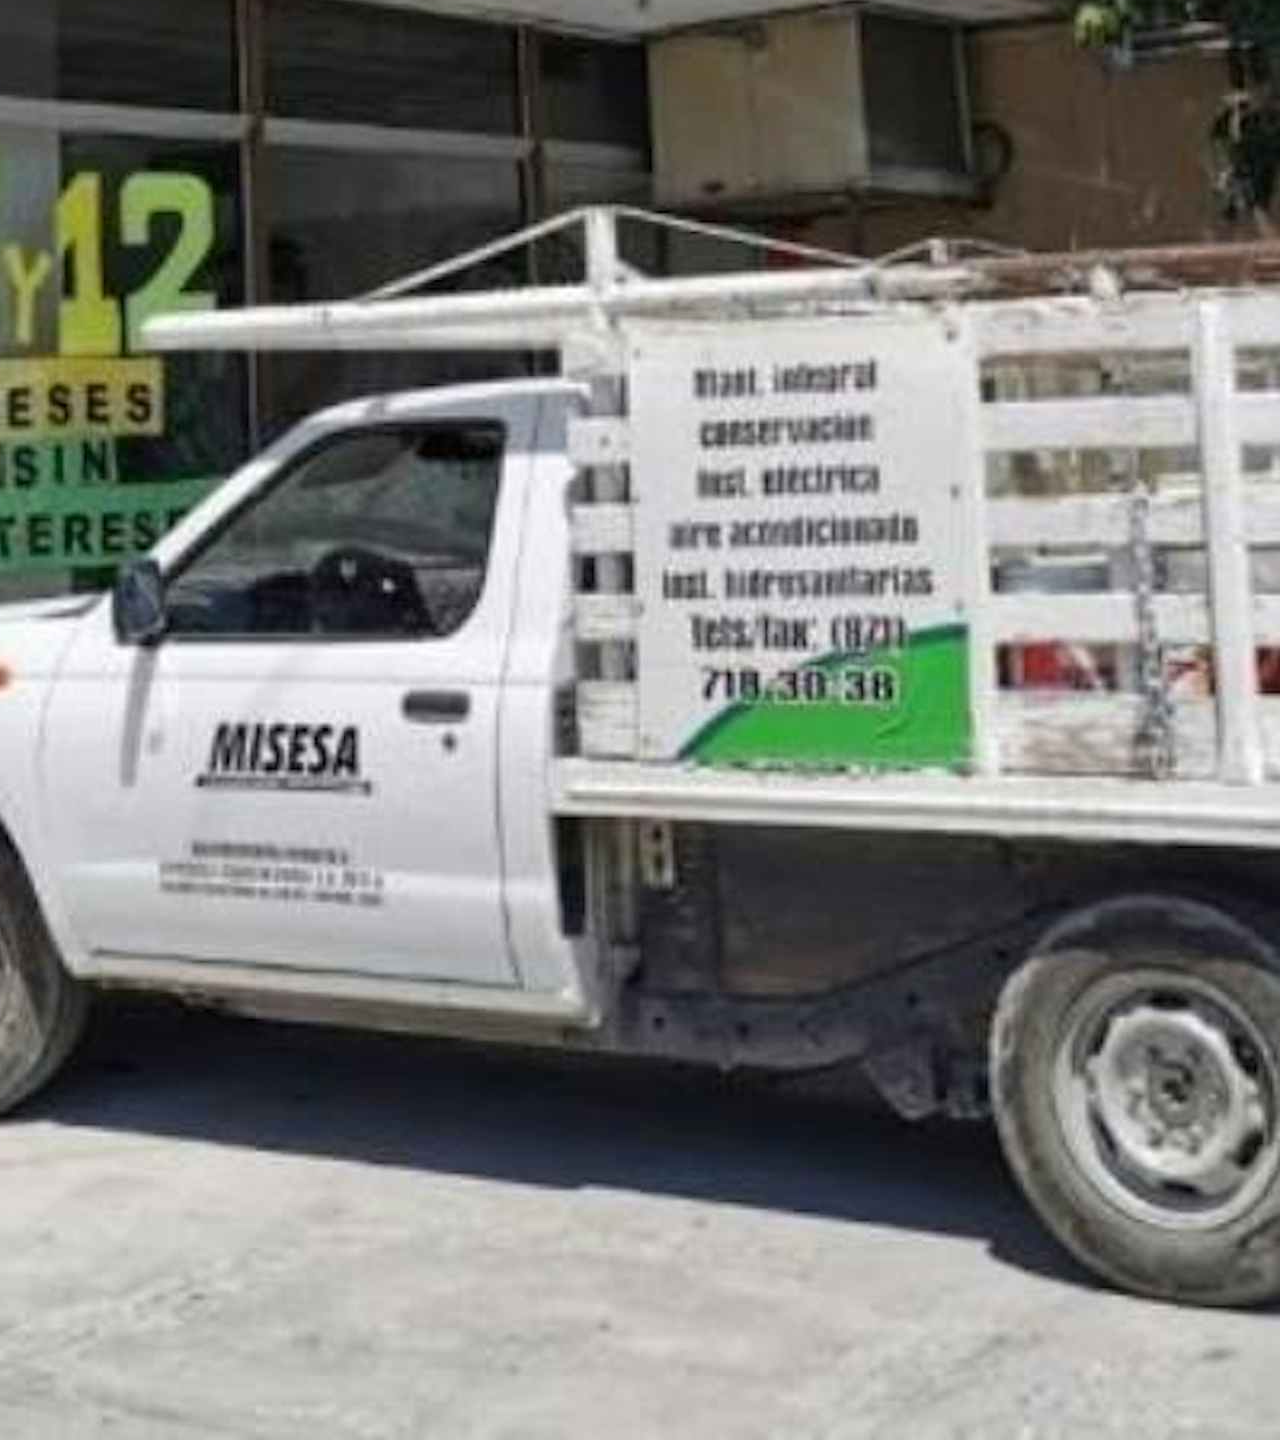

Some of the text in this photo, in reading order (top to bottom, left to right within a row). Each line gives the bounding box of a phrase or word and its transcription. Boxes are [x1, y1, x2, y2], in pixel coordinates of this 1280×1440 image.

[55, 170, 216, 356] 12
[12, 441, 112, 488] SIN
[208, 721, 360, 776] MISESA
